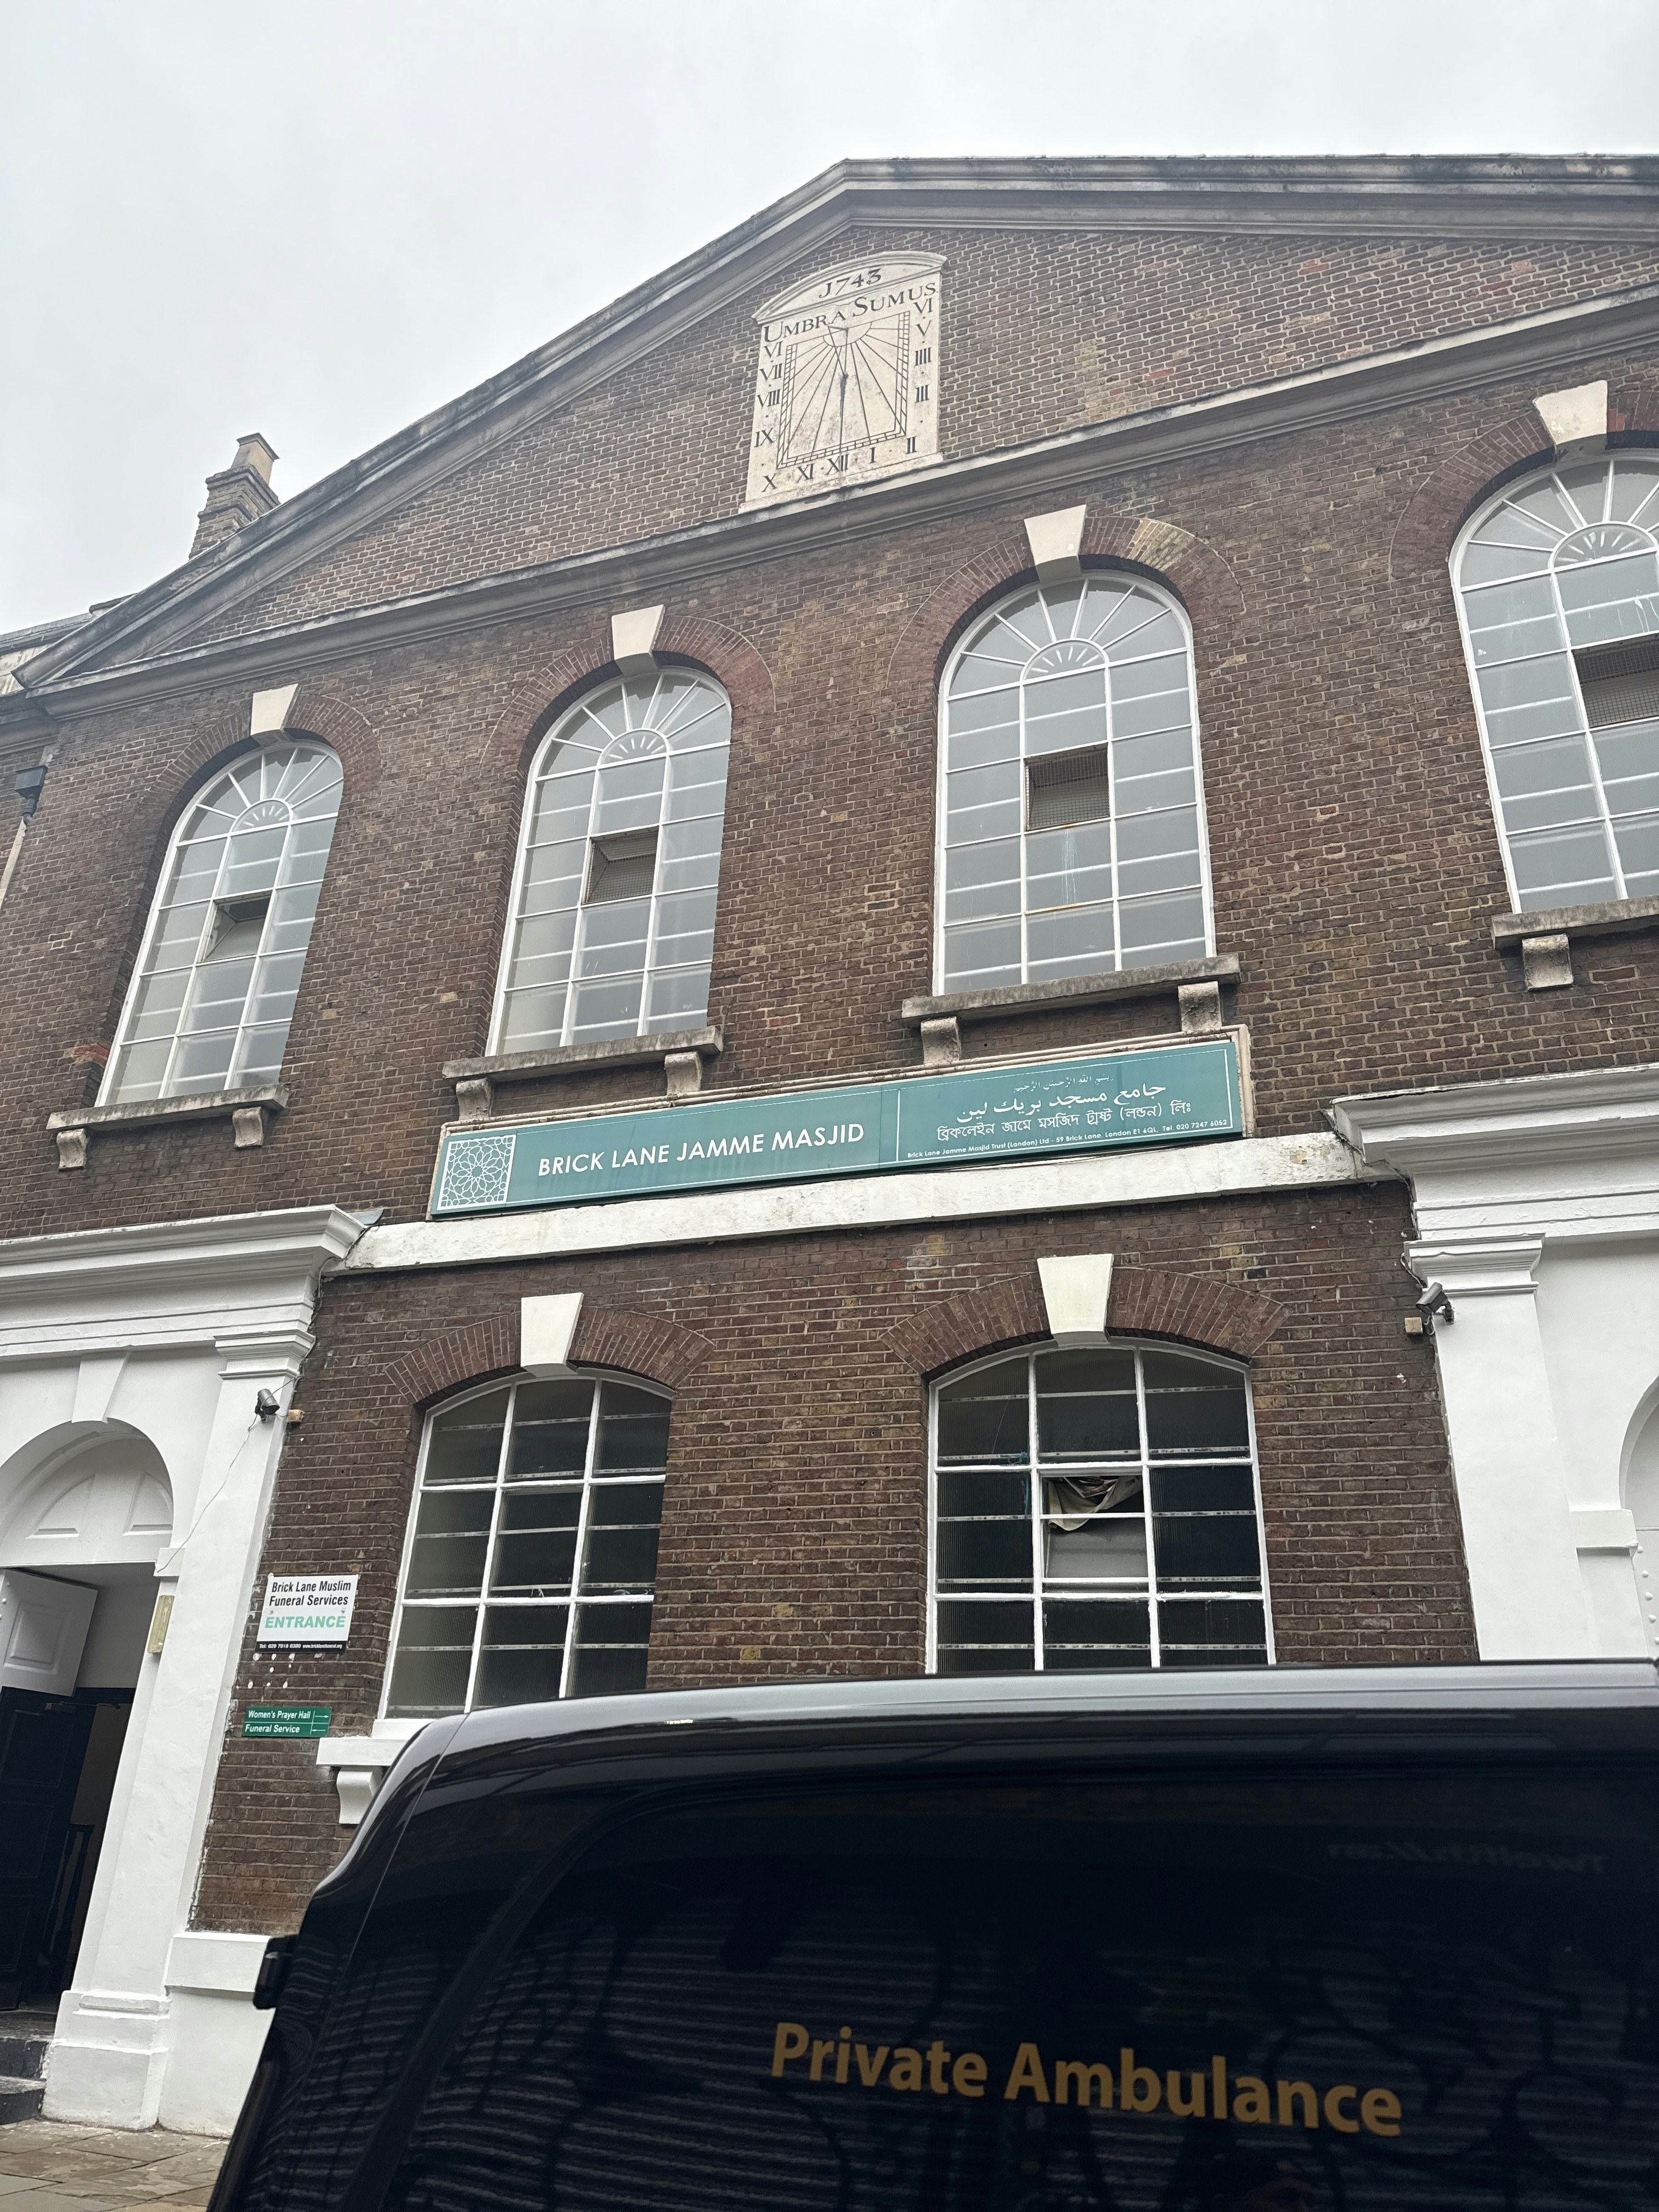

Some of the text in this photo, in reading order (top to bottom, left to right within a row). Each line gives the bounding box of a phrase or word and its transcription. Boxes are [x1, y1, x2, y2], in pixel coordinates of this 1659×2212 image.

[913, 297, 933, 314] VI
[763, 311, 847, 342] UMBRA
[916, 320, 932, 337] V
[763, 342, 781, 359] VI
[915, 347, 932, 366] IIII
[760, 363, 783, 382] VII
[757, 389, 780, 408] VIII
[916, 385, 929, 403] III
[754, 427, 774, 447] IX
[763, 473, 777, 492] X
[797, 464, 814, 482] XI
[826, 454, 849, 475] XII
[906, 436, 917, 454] II
[957, 1083, 1166, 1123] جامع مسجد بريك لين
[1002, 1119, 1032, 1131] জামে
[1037, 1113, 1080, 1128] মসজিদ
[538, 1124, 864, 1176] BRICK LANE JAMME MASJID
[968, 1144, 990, 1153] Masjid
[1008, 1139, 1037, 1148] (London)
[1085, 1132, 1103, 1140] Lane,
[1105, 1129, 1131, 1137] London
[272, 1580, 351, 1593] Brick Lane Muslim
[269, 1594, 348, 1606] Funeral Services
[264, 1616, 346, 1628] ENTRANCE
[248, 1710, 311, 1721] Women's Prayer Hall
[245, 1724, 300, 1733] Funeral Service
[771, 2021, 1403, 2137] Private Ambulance
